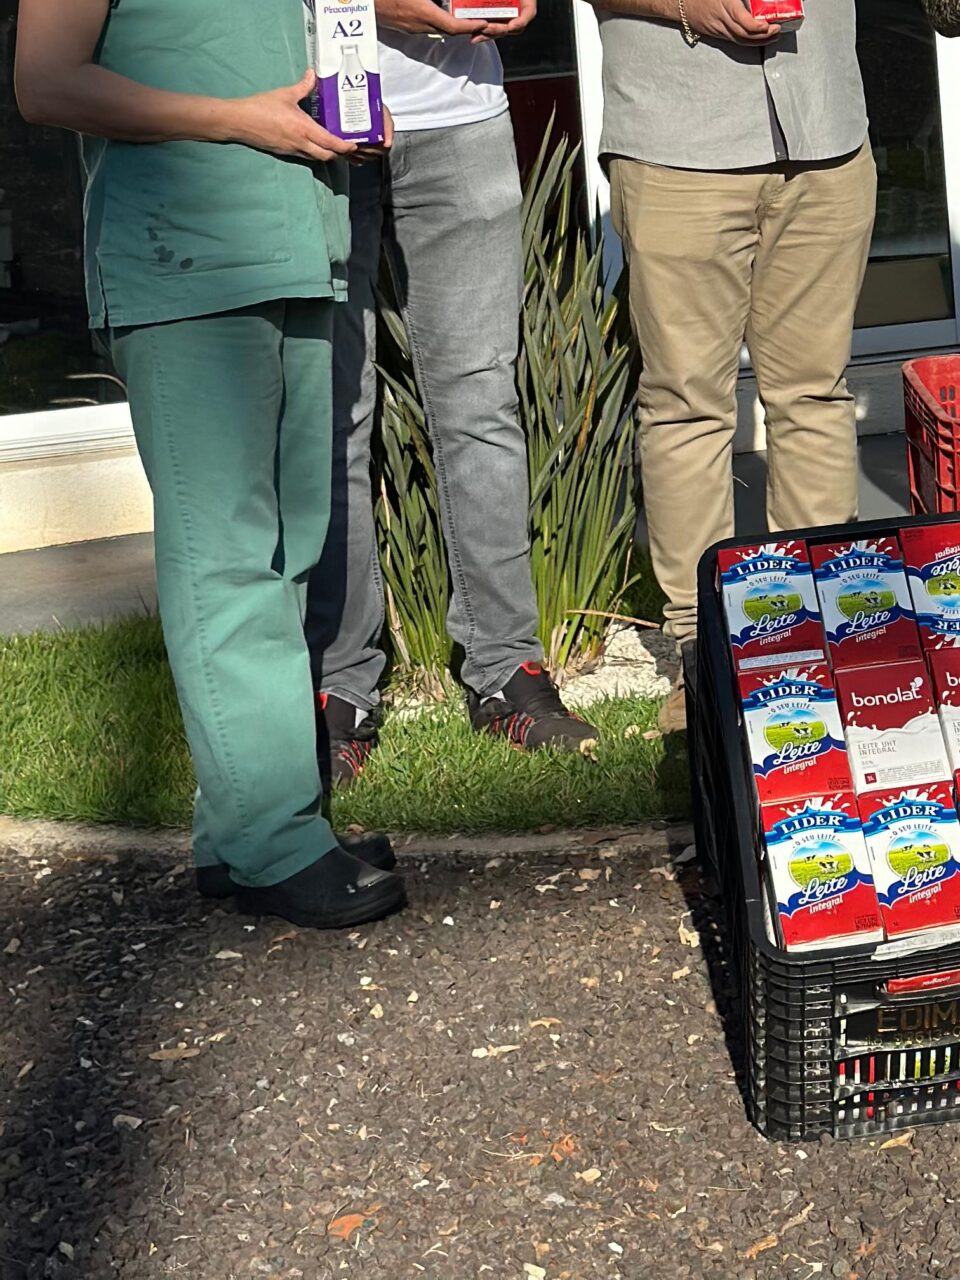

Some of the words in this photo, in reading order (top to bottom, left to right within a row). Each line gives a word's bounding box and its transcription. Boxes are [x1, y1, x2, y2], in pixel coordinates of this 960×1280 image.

[324, 4, 368, 14] Piracanjuba
[332, 19, 363, 39] A2
[341, 74, 366, 89] A2
[737, 560, 794, 575] LIDER
[829, 557, 885, 572] LIDER
[750, 610, 797, 636] Leite
[846, 611, 891, 633] Leite
[759, 629, 792, 646] integral
[855, 626, 886, 642] integral
[757, 685, 817, 702] LIDER
[851, 686, 922, 707] bonolat
[773, 741, 822, 765] Leite
[858, 742, 878, 750] LEITE
[860, 747, 896, 755] INTEGRAL
[783, 757, 817, 774] integral
[877, 805, 938, 824] LIDER
[781, 815, 842, 834] LIDER
[898, 865, 946, 894] Leite
[798, 878, 848, 904] Leite
[909, 882, 942, 903] integral
[809, 895, 844, 915] integral
